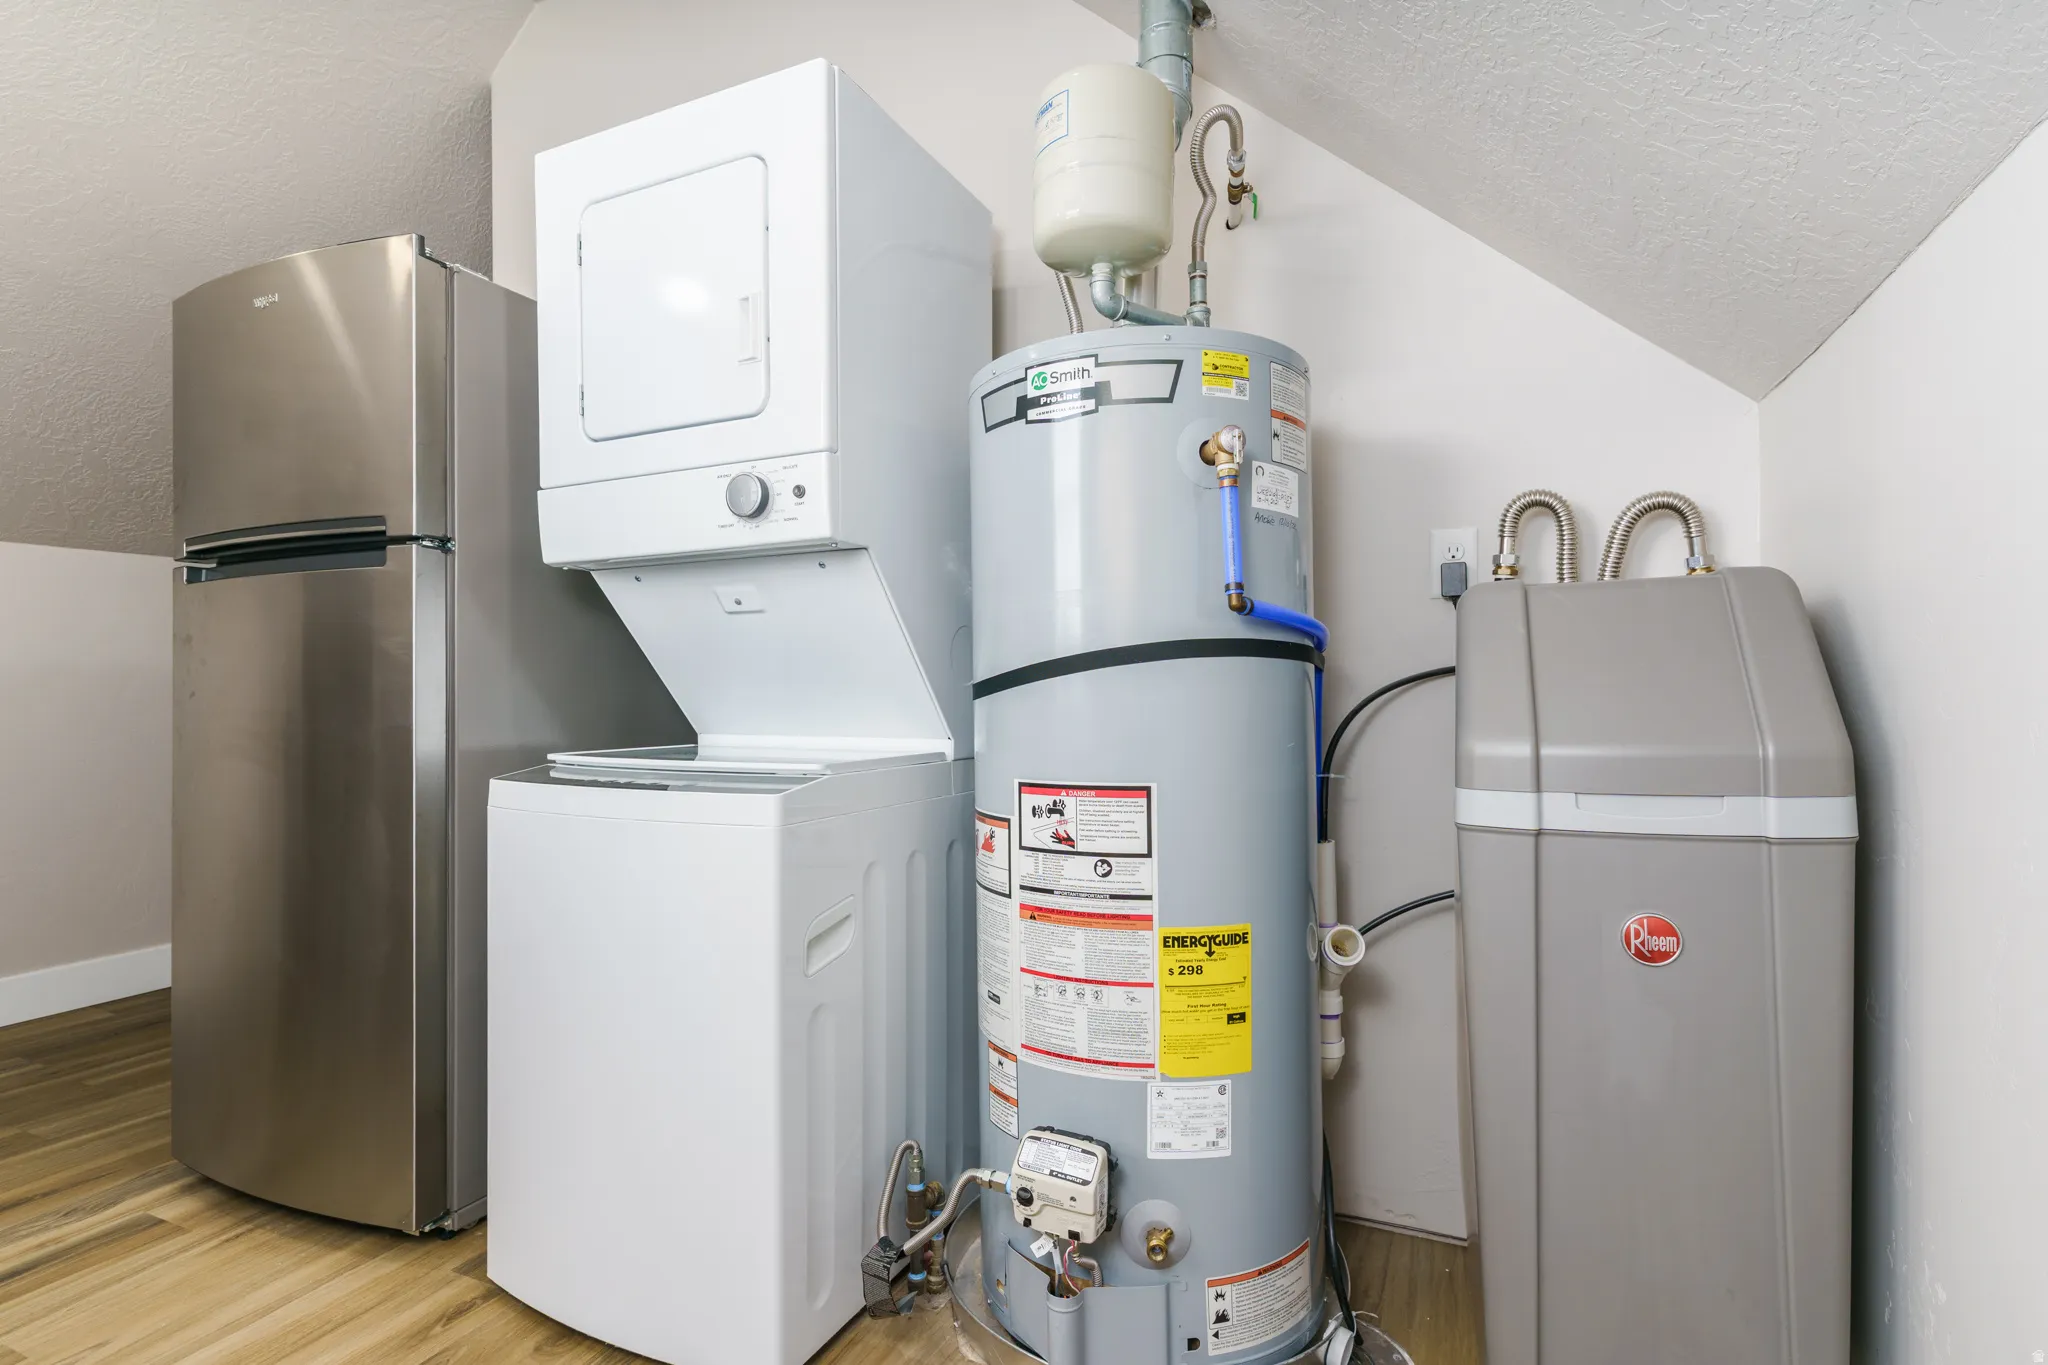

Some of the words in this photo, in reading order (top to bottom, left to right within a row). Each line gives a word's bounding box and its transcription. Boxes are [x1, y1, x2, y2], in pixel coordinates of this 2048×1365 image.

[1050, 366, 1091, 384] Smith
[1040, 392, 1079, 405] ProLine
[1163, 932, 1249, 949] ENERGYGUIDE
[1629, 918, 1678, 957] Rheem
[1168, 967, 1175, 976] $
[1178, 965, 1203, 976] 298
[1070, 1145, 1082, 1153] CODE
